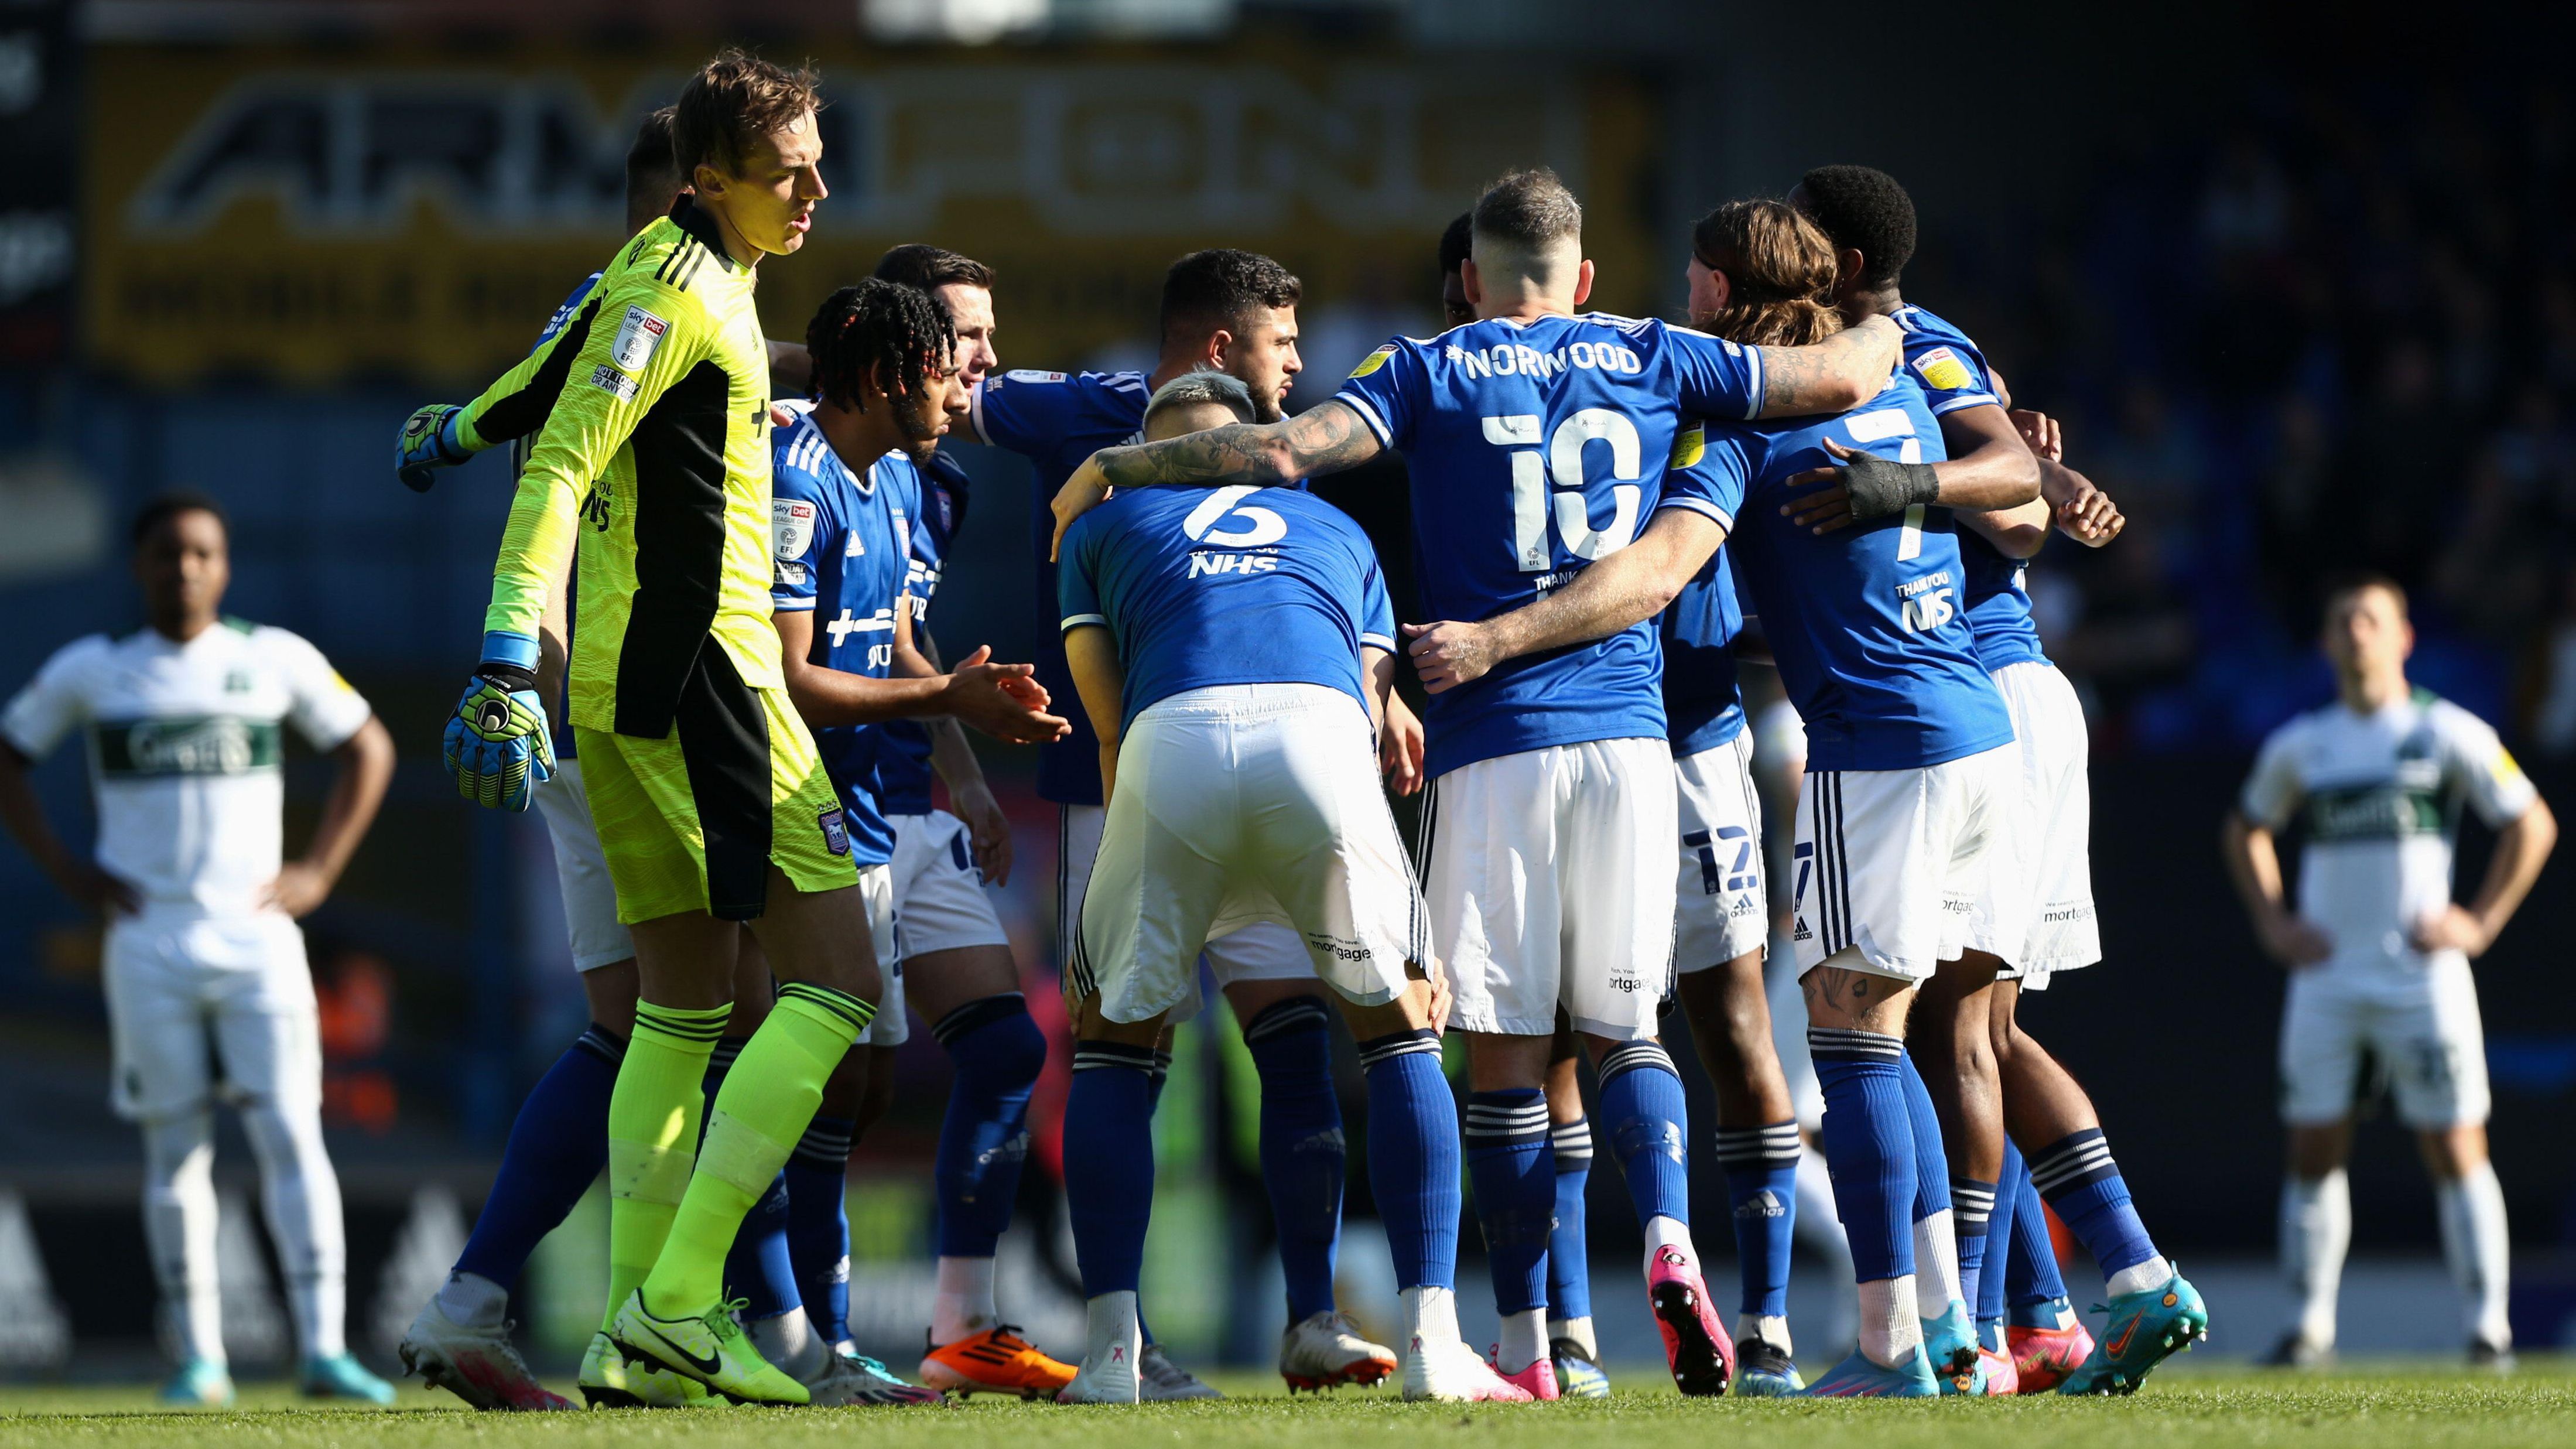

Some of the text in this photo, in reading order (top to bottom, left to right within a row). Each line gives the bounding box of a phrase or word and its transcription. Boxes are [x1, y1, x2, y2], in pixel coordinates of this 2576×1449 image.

[625, 322, 659, 343] LEAGUE ONE
[628, 310, 662, 333] sky bet
[621, 353, 634, 364] EFL
[1464, 341, 1641, 380] NORWOOD
[1918, 356, 1932, 367] sky
[591, 375, 602, 385] OR
[602, 380, 620, 394] ANY
[596, 365, 639, 394] NOT TODAY
[1482, 408, 1641, 573] 10
[1845, 409, 1925, 561] 7
[579, 487, 610, 532] NS
[774, 504, 810, 517] sky bet
[774, 515, 796, 525] LEAGUE
[1183, 484, 1288, 547] 6
[781, 546, 793, 554] EFL
[1188, 553, 1278, 579] NHS
[1534, 570, 1578, 591] THANK
[1895, 577, 1928, 597] THAN
[1902, 588, 1953, 634] NS
[1682, 826, 1757, 896] 12
[1794, 842, 1813, 913] 7
[1730, 908, 1759, 918] adidas
